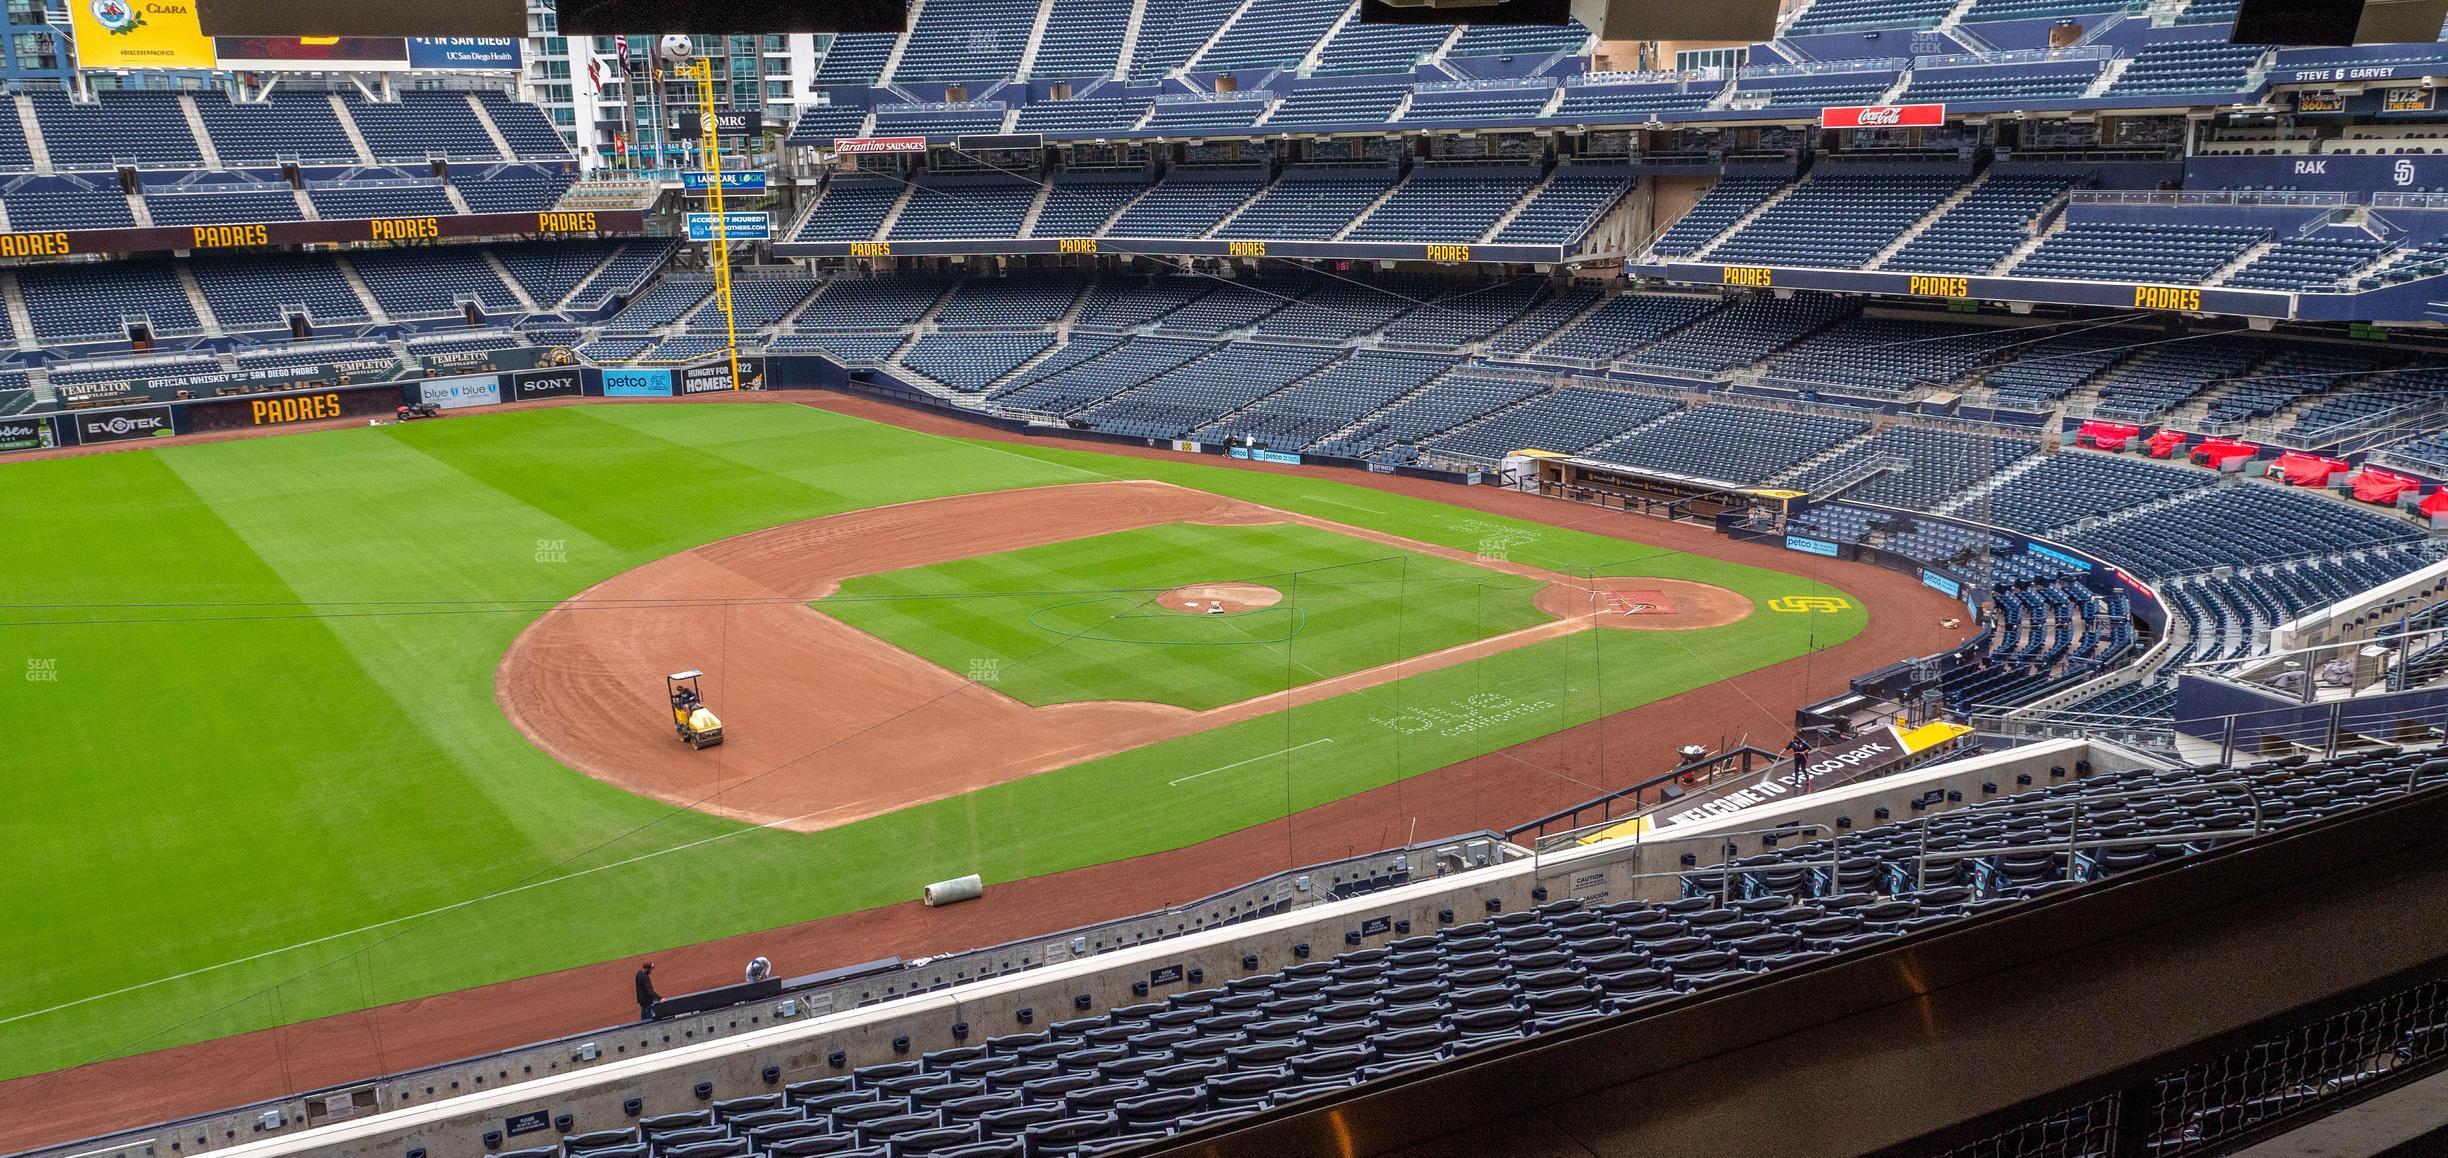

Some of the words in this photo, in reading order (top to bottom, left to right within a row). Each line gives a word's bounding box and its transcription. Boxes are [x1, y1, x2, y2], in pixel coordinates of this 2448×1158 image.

[146, 3, 187, 14] CLARA
[450, 37, 474, 46] SAN
[491, 52, 512, 60] Health
[2296, 71, 2330, 81] STEVE
[2335, 69, 2344, 80] 6
[2350, 68, 2395, 78] GARVEY
[2388, 89, 2420, 103] 97.3
[2388, 102, 2405, 110] THE
[2407, 102, 2426, 110] FAN
[719, 115, 746, 126] MRC
[837, 140, 885, 152] Tarantino
[886, 141, 924, 151] SAUSAGES
[2295, 161, 2327, 174] RAK
[740, 174, 764, 182] LOGIC
[371, 218, 438, 239] PADRES
[539, 212, 596, 232] PADRES
[193, 225, 268, 248] PADRES
[851, 242, 890, 256] PADRES
[1060, 239, 1097, 252] PADRES
[1230, 242, 1265, 256] PADRES
[1427, 245, 1469, 260] PADRES
[1724, 267, 1771, 286] PADRES
[1910, 276, 1968, 297] PADRES
[2135, 286, 2200, 311] PADRES
[431, 351, 489, 365] TEMPLETON
[333, 359, 394, 373] TEMPLETON
[688, 368, 714, 378] HUNGRY
[716, 366, 729, 376] FOR
[738, 363, 752, 373] 322
[149, 377, 188, 388] OFFICIAL
[190, 374, 229, 384] WHISKEY
[250, 370, 266, 380] SAN
[267, 368, 289, 378] DIEGO
[291, 366, 319, 376] PADRES
[607, 375, 646, 390] petco
[686, 375, 733, 393] HOMERS
[60, 382, 131, 396] TEMPLETON
[462, 385, 486, 395] blue
[524, 378, 573, 392] SONY
[424, 387, 448, 399] blue
[253, 393, 341, 425] PADRES
[88, 416, 162, 434] EVOTEK
[1231, 449, 1246, 457] petco
[1265, 453, 1282, 461] petco
[1788, 538, 1811, 549] petco
[1754, 781, 1787, 801] TO
[1842, 741, 1892, 766] park
[1576, 872, 1604, 884] CAUTION
[1584, 890, 1609, 901] AUCIÓN
